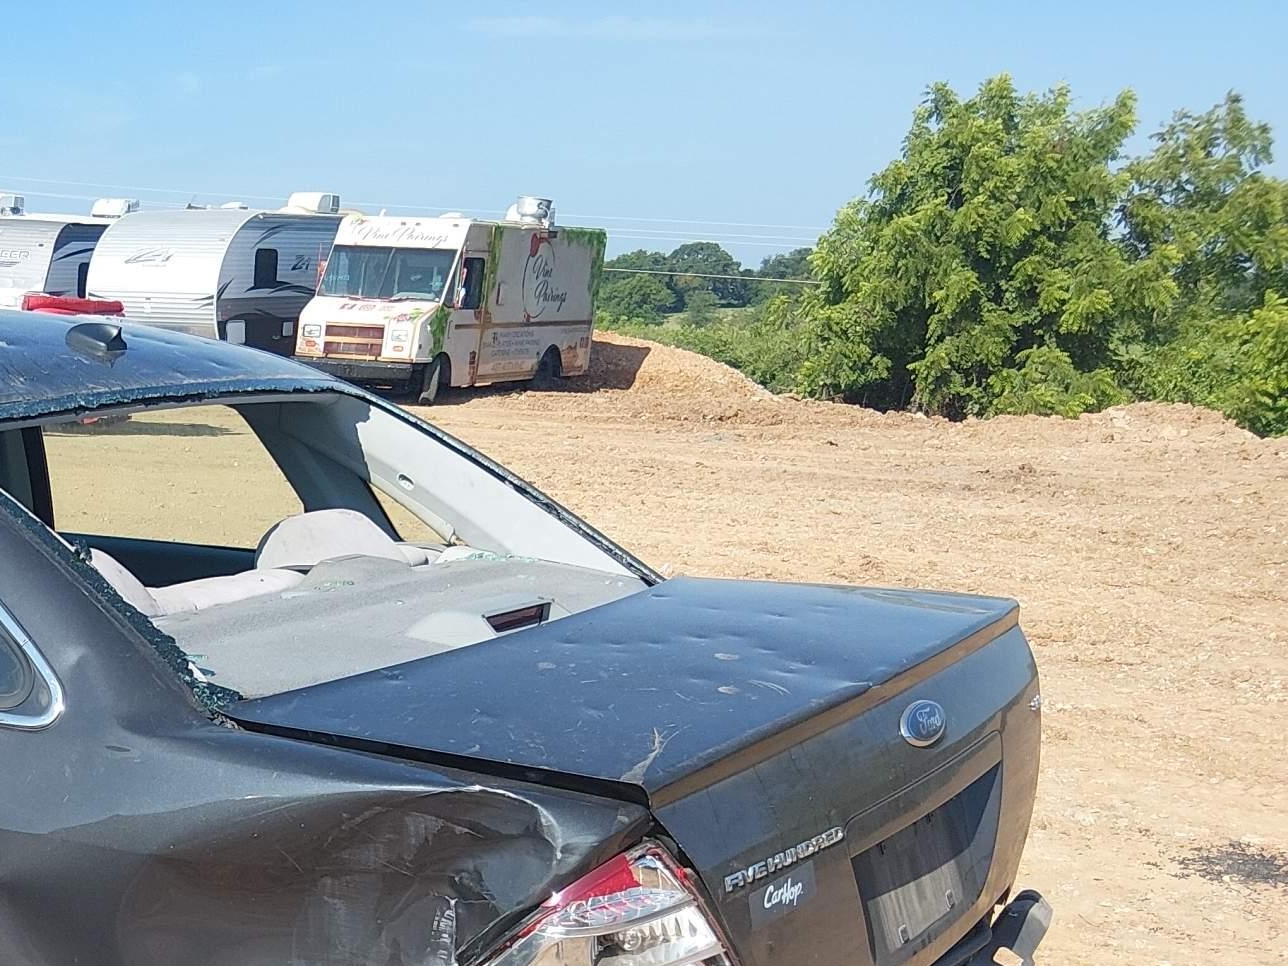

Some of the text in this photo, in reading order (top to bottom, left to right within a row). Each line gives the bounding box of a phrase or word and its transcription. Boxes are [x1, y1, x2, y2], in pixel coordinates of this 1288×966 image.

[533, 255, 553, 280] Vine
[534, 280, 568, 312] Pairings
[767, 826, 844, 873] HUNDRED
[763, 877, 804, 909] CarHop
